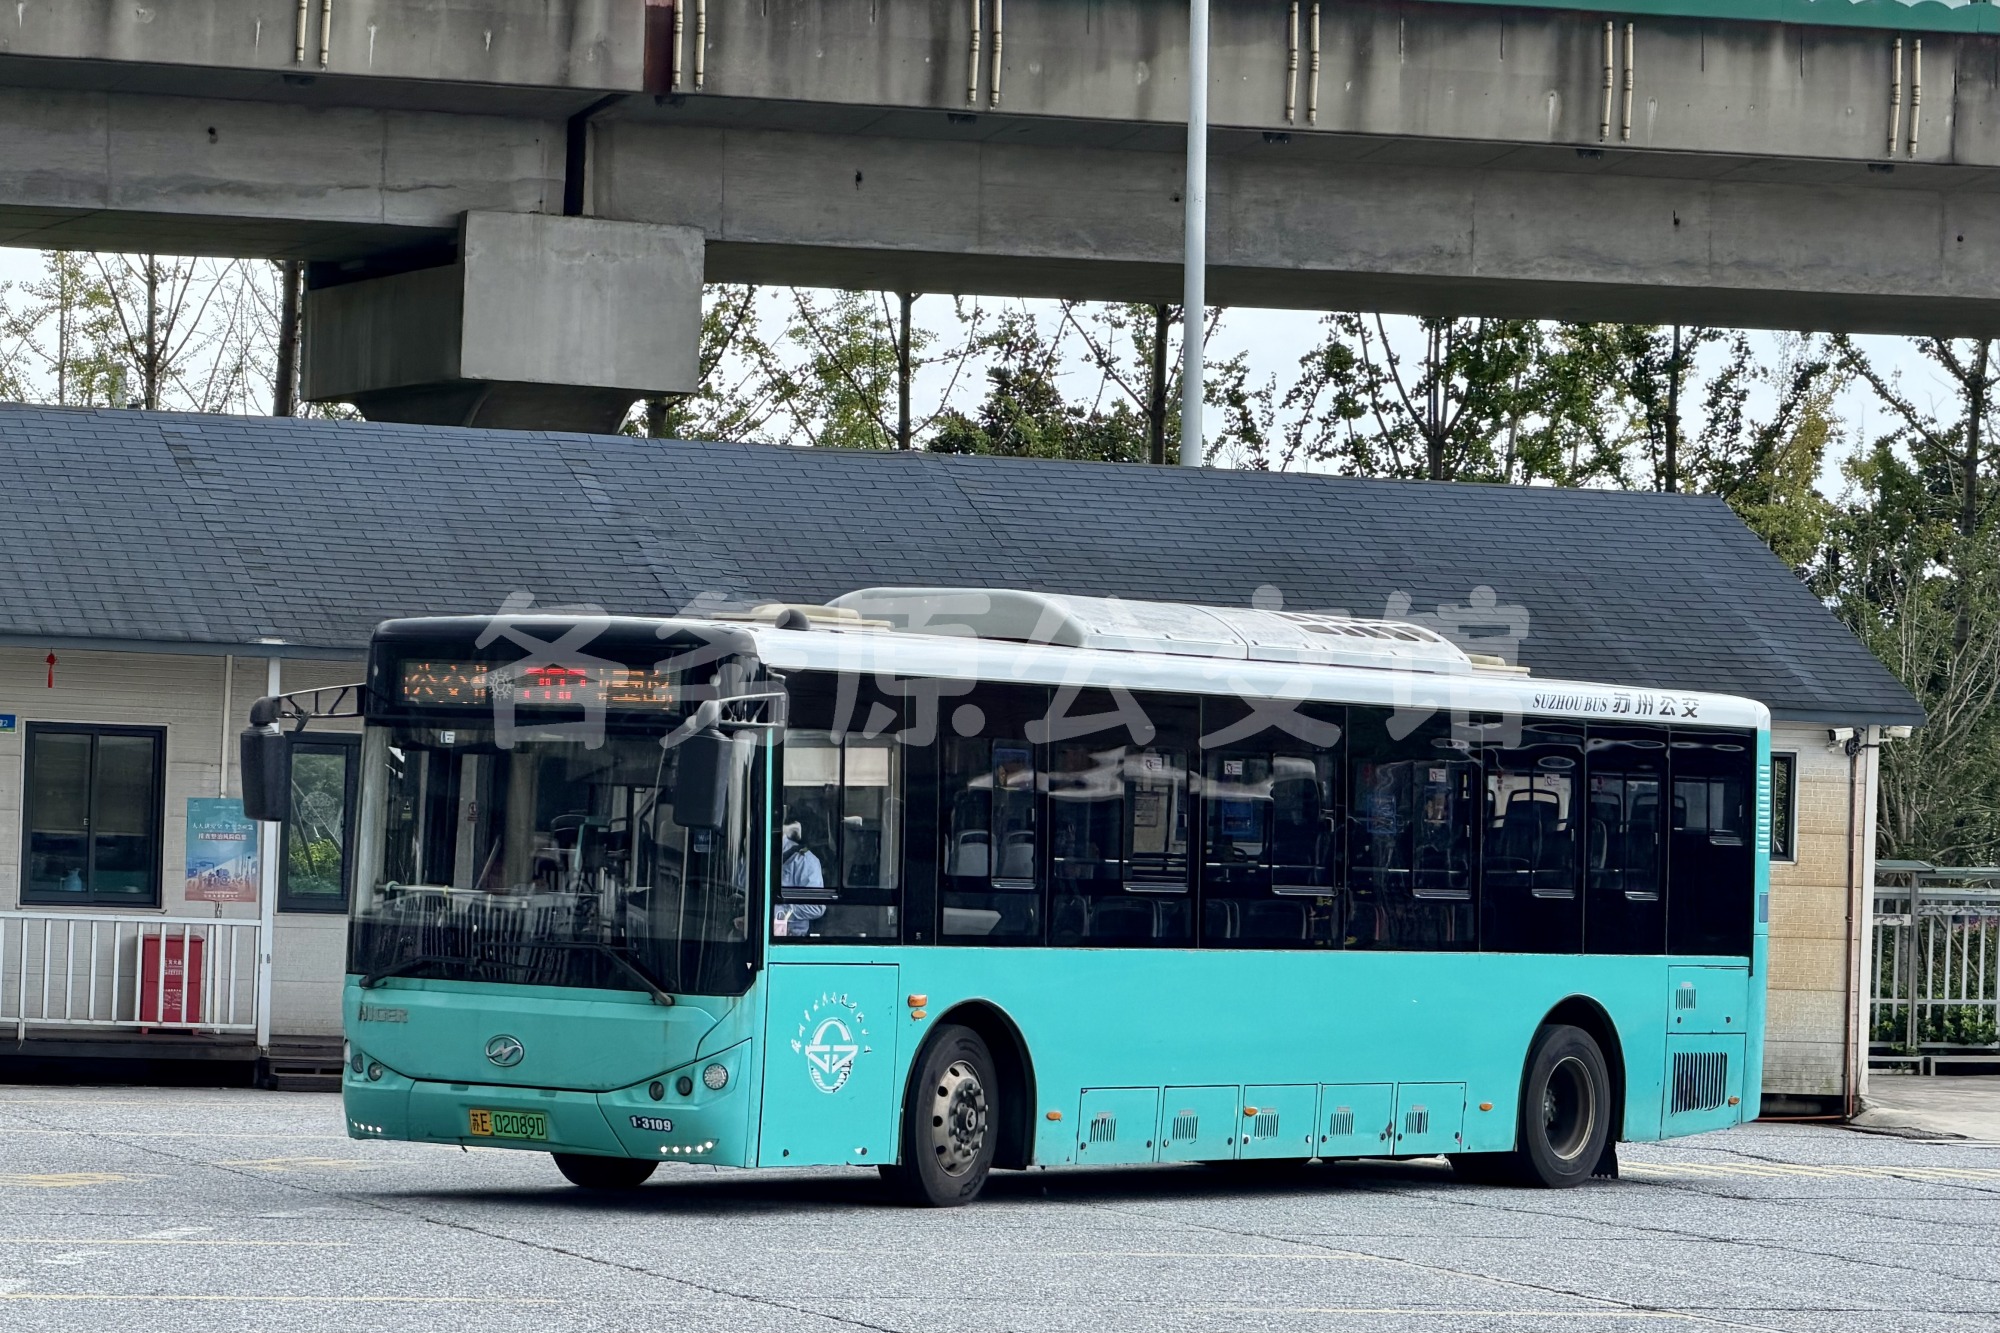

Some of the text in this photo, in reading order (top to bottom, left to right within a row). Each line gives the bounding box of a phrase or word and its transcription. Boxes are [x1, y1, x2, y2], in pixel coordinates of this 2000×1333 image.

[1532, 694, 1608, 713] SUZHOU BUS
[1612, 692, 1700, 718] 苏州公交
